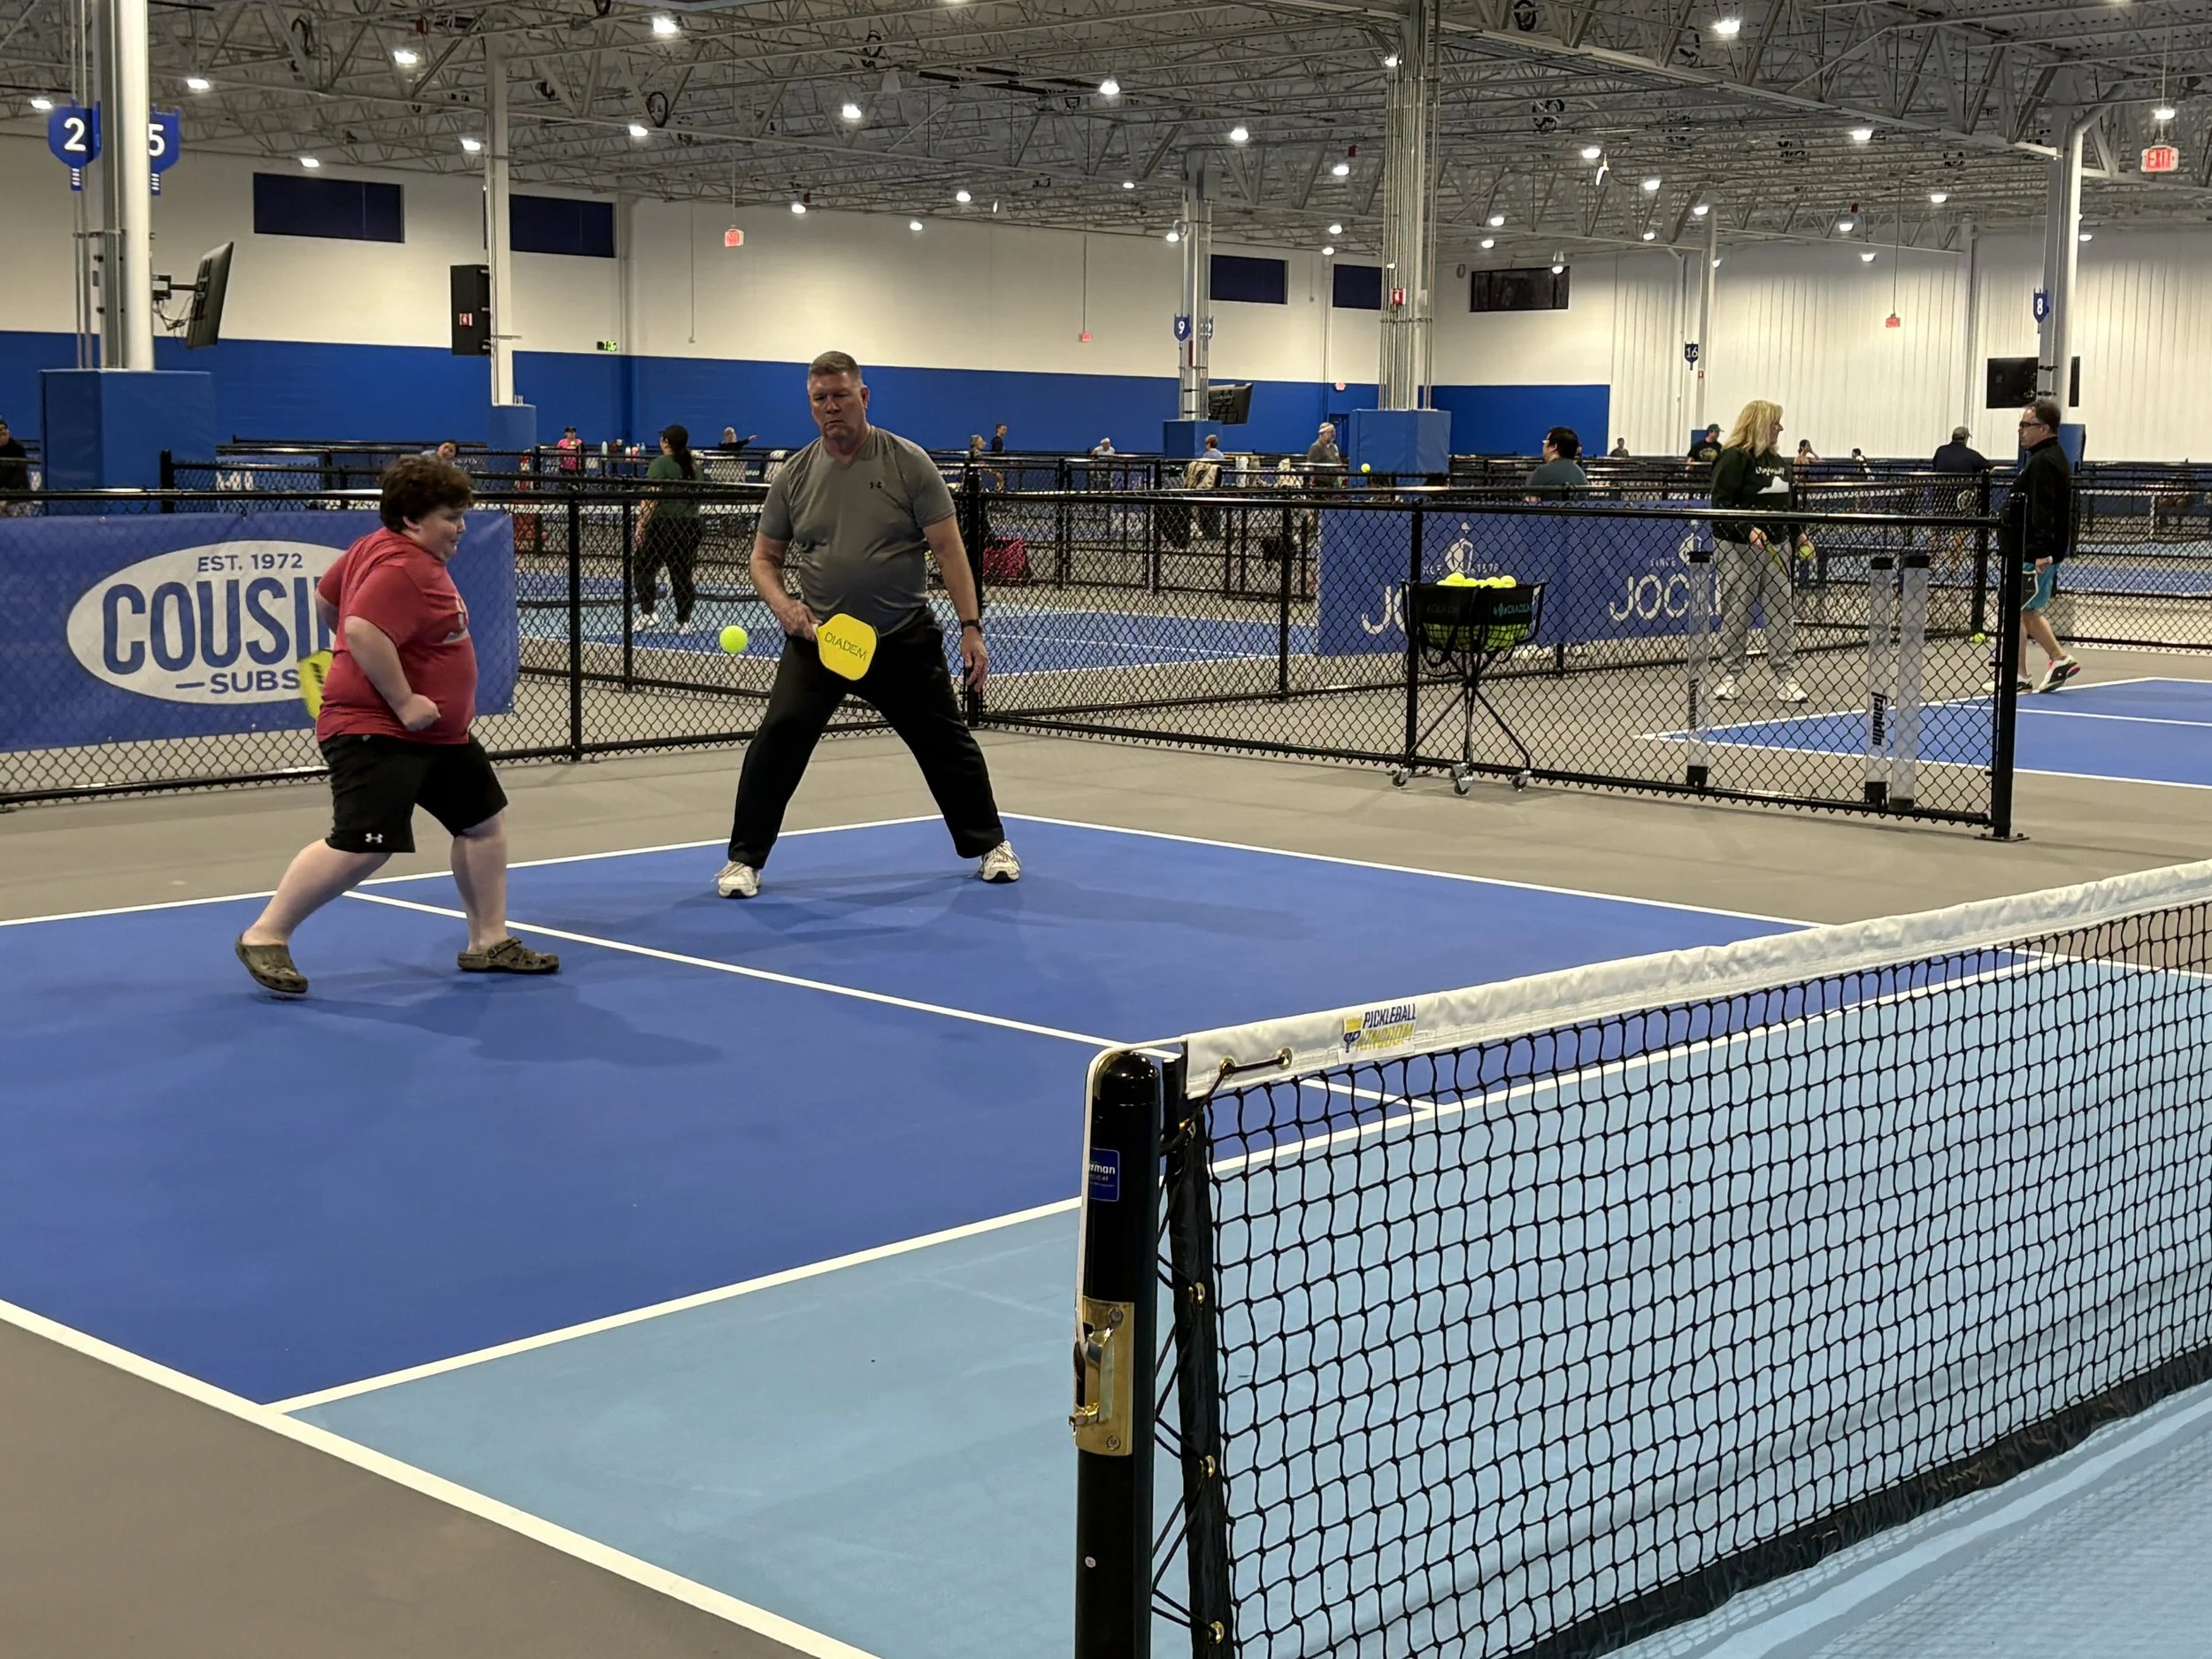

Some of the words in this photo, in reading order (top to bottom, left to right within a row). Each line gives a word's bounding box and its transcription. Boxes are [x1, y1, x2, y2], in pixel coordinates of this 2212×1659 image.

[64, 117, 87, 151] 2
[148, 123, 165, 157] 5
[2037, 297, 2043, 316] 8
[1179, 320, 1186, 334] 9
[1686, 346, 1698, 358] 16
[197, 555, 243, 572] EST.
[250, 553, 303, 569] 1972
[825, 631, 867, 661] DIADEM
[211, 668, 301, 695] SUBS
[1870, 691, 1887, 746] Franklin
[1363, 1002, 1416, 1029] PICKLEBALL
